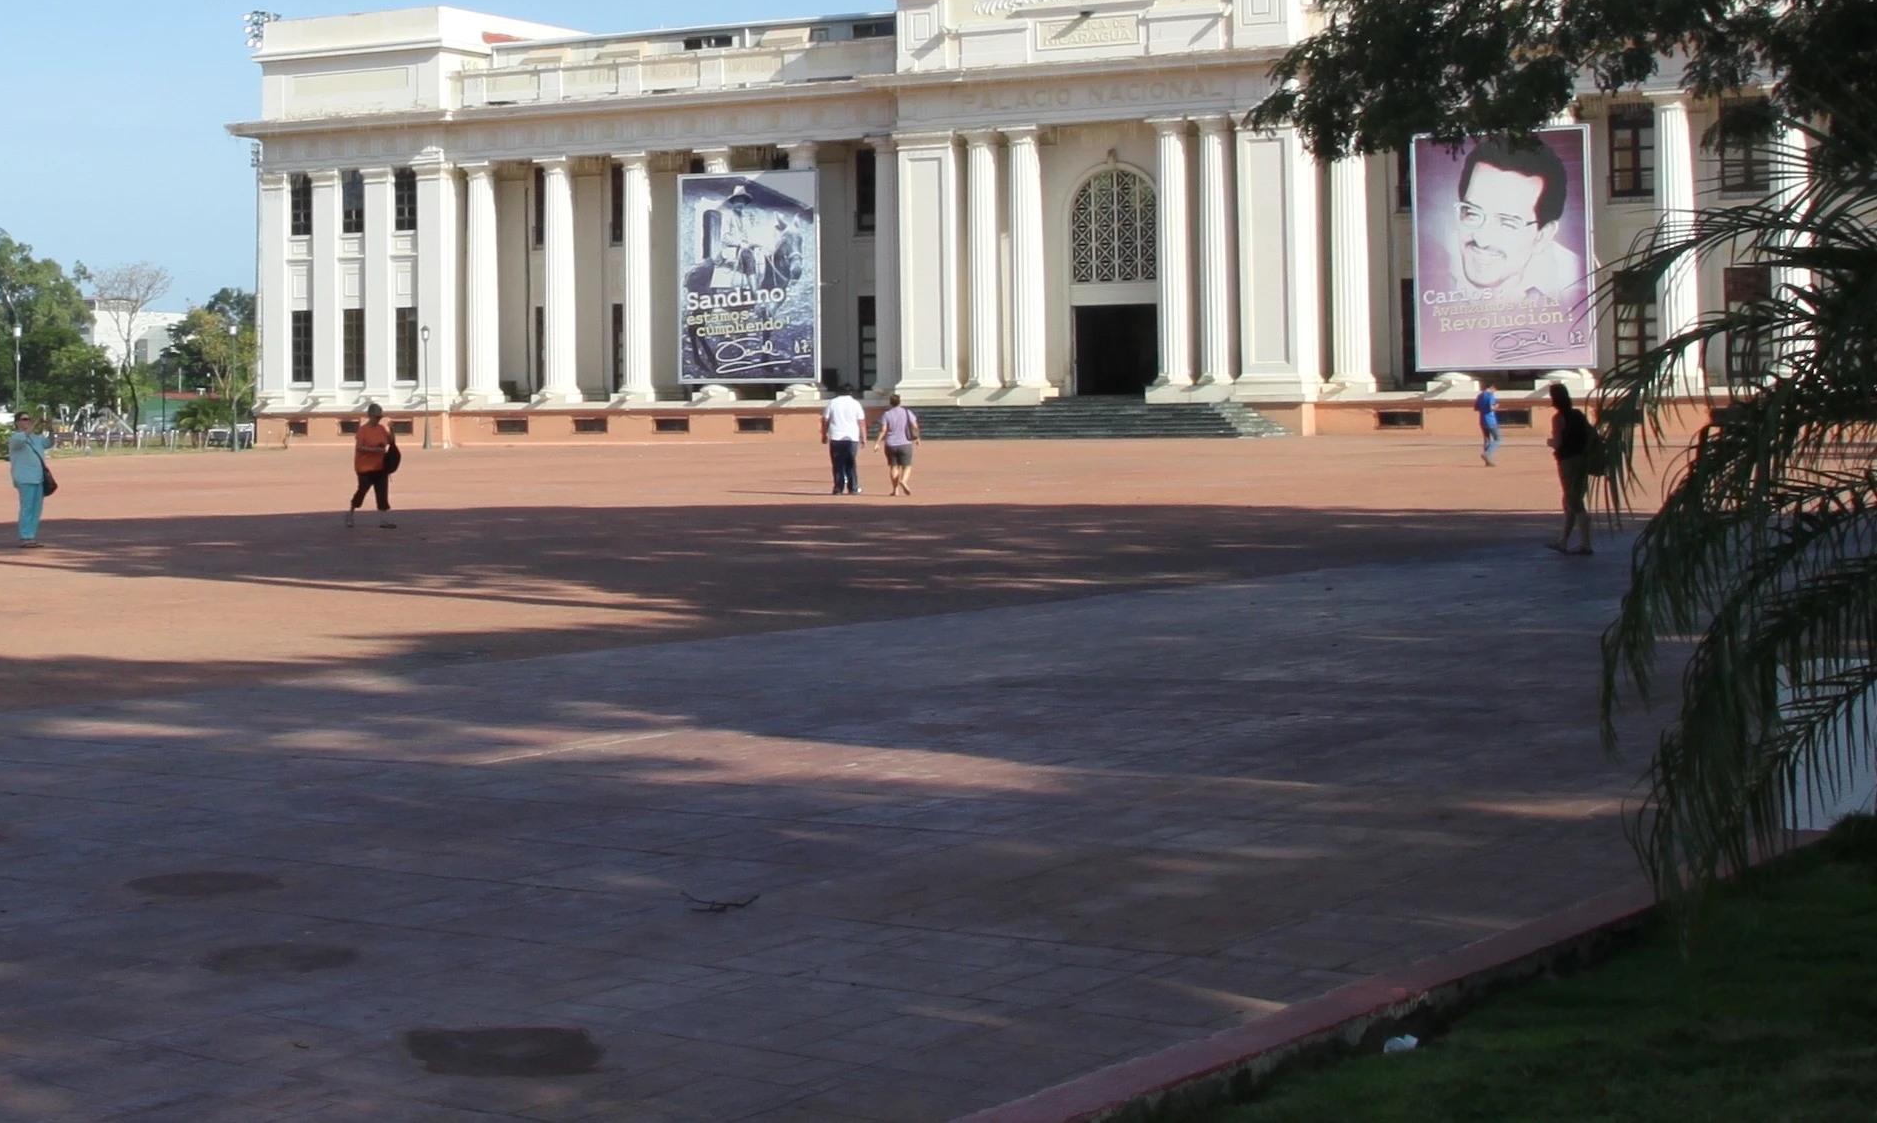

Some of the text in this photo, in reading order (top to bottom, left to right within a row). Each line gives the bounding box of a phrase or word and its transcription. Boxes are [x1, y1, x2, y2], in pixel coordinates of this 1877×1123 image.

[961, 78, 1223, 113] PALACIO NACIONAL
[1519, 300, 1537, 310] en
[1544, 295, 1560, 307] la
[687, 310, 749, 326] estamos
